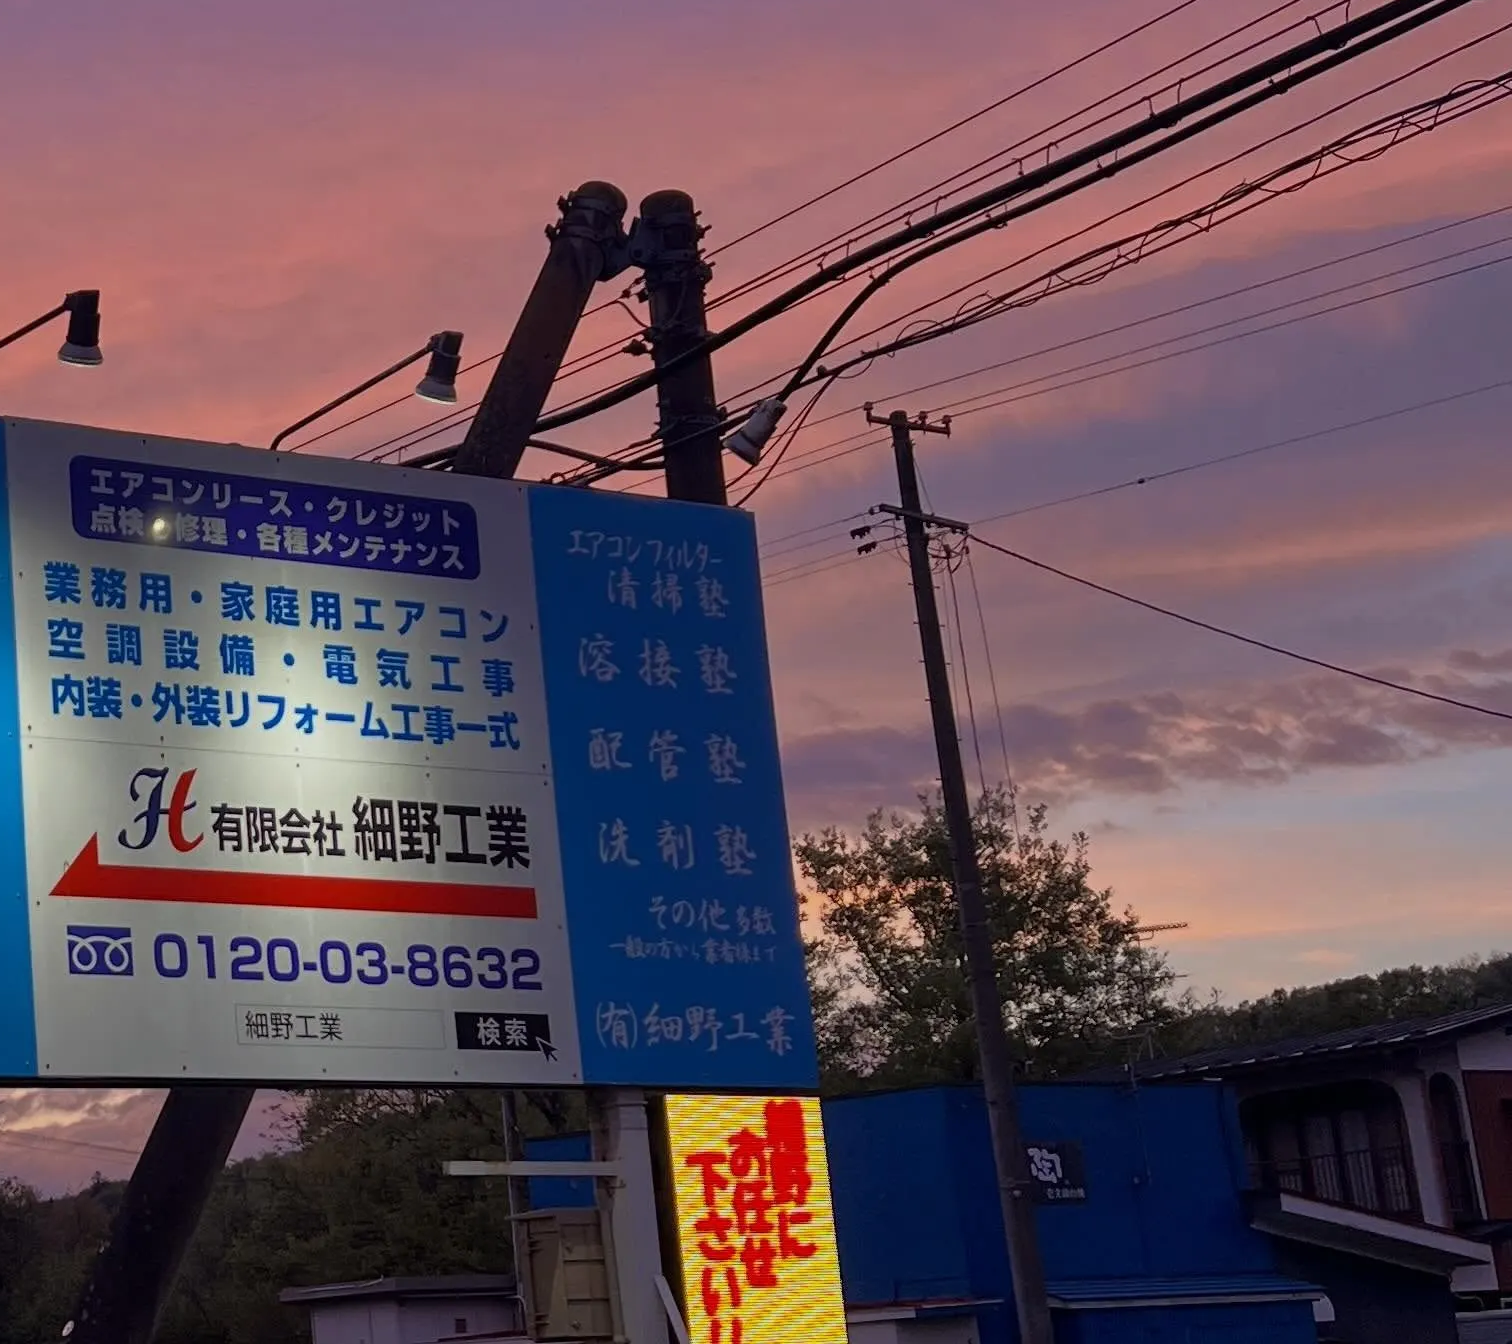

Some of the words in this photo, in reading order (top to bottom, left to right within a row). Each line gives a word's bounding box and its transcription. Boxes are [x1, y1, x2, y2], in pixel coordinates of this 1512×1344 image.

[90, 467, 461, 535] エアコンリース・クレジット
[567, 530, 722, 573] エアコンフィルター
[43, 561, 509, 643] 業務用・家庭用エアコン
[607, 566, 729, 618] 清掃塾
[47, 618, 516, 698] 空調設備・電気工事
[578, 633, 738, 695] 溶接塾
[51, 674, 521, 751] 内装・外装リフォーム工事一式
[589, 728, 747, 785] 配管塾
[153, 932, 543, 991] 0120-03-8632
[244, 1010, 344, 1041] 細野工業
[476, 1016, 530, 1047] 検索
